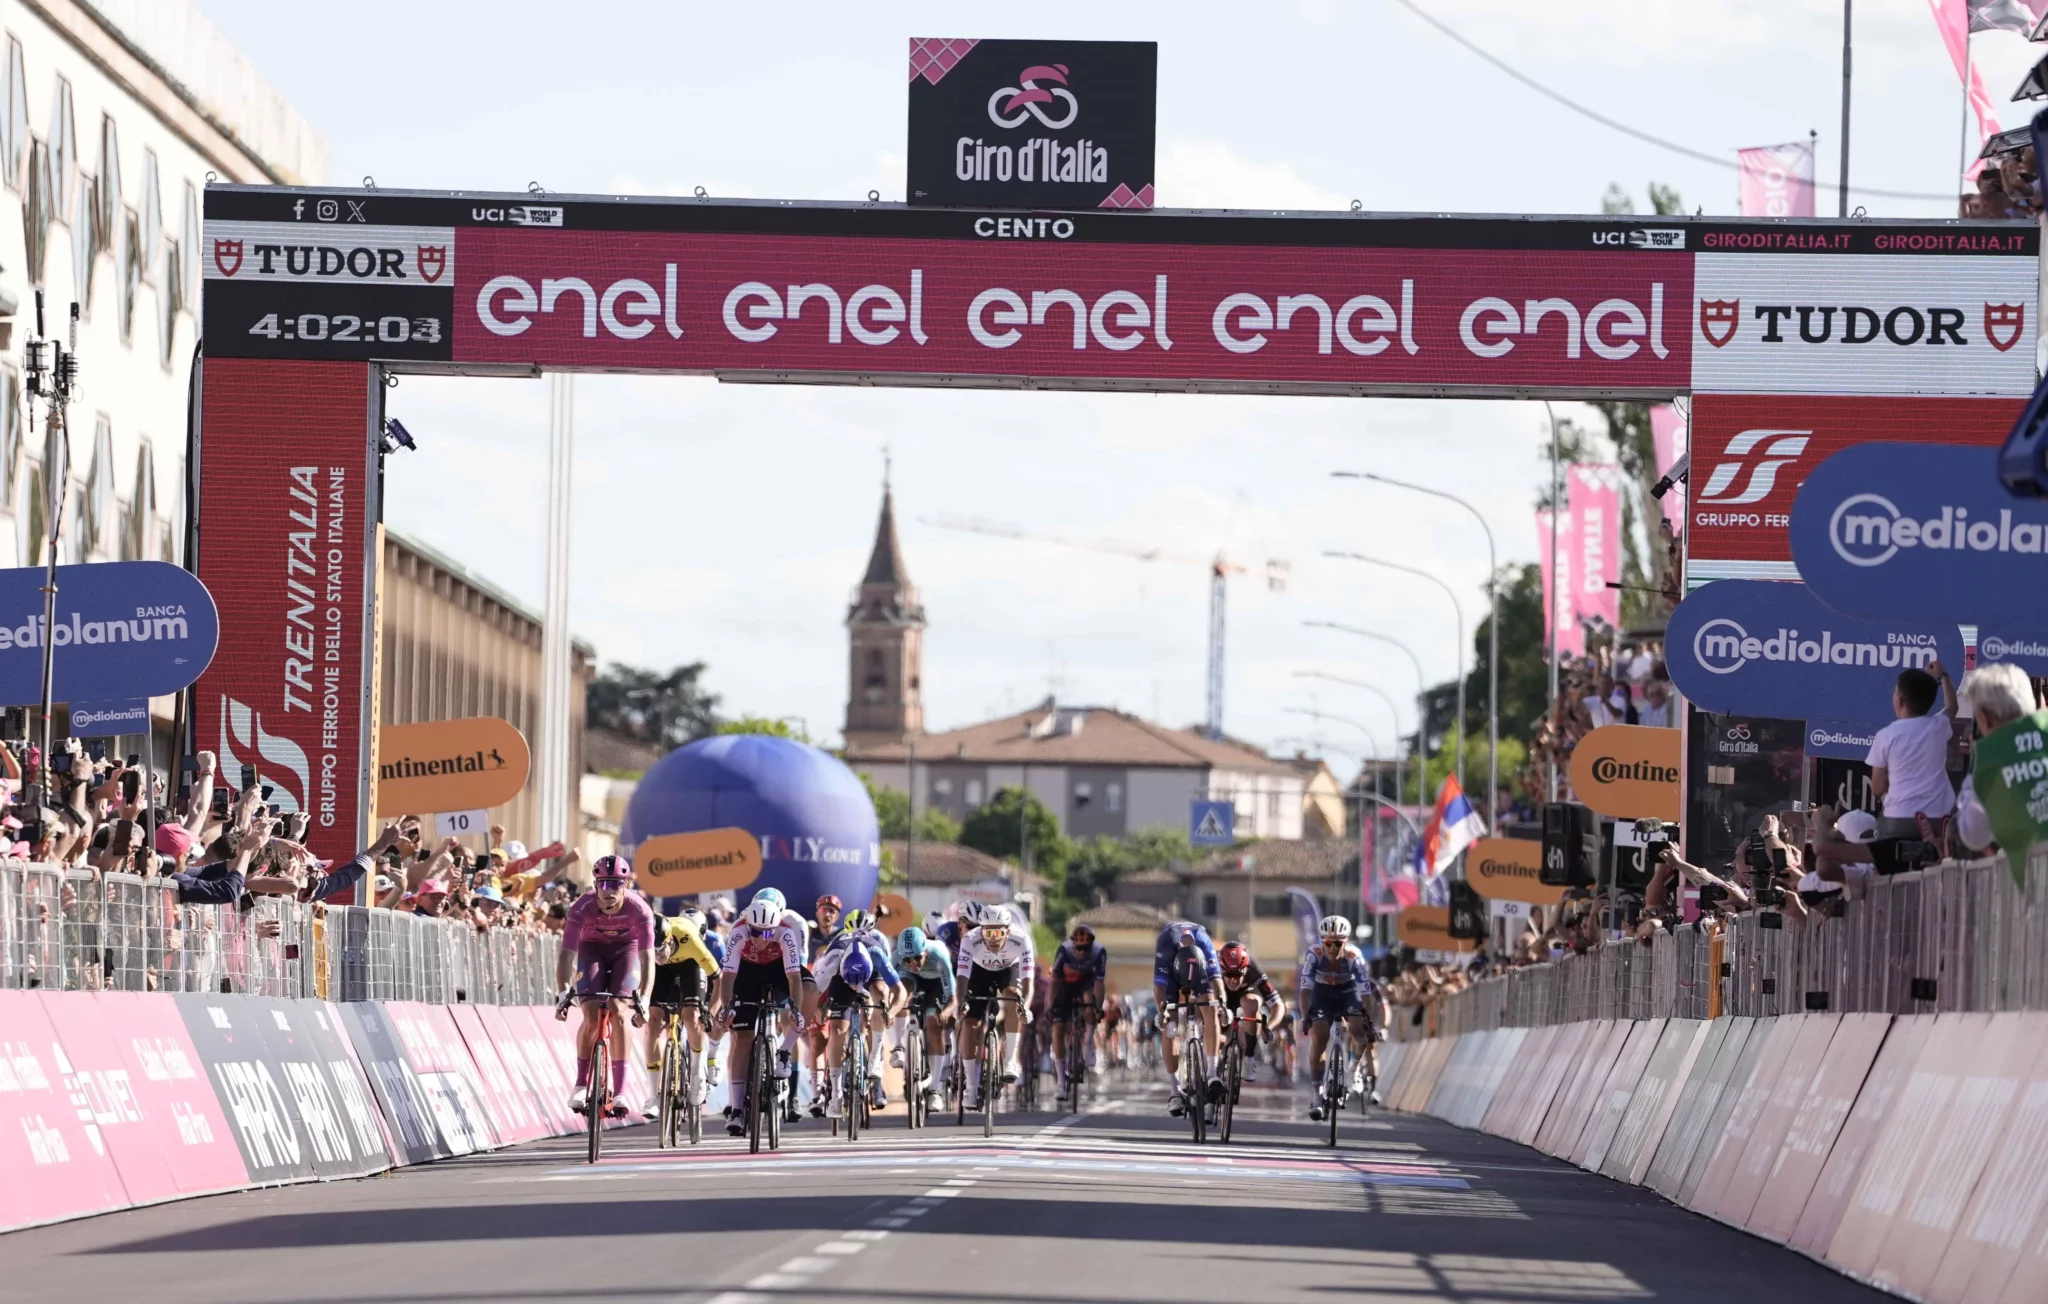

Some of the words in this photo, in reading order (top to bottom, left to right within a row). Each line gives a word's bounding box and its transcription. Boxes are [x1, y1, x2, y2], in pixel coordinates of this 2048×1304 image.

[956, 137, 1012, 182] Giro
[1018, 138, 1108, 184] d'Italia
[472, 208, 504, 221] UCI
[530, 209, 558, 218] WORLD
[531, 216, 551, 224] TOUR
[974, 217, 1075, 238] CENTO
[1651, 231, 1680, 240] WORLD
[1593, 231, 1624, 245] UCI
[1652, 238, 1674, 246] TOUR
[1704, 233, 1852, 249] GIRODITALIA.IT
[1874, 234, 2024, 251] GIRODITALIA.IT
[254, 244, 407, 279] TUDOR
[476, 263, 684, 340] enel
[722, 269, 929, 346] enel
[967, 275, 1173, 351] enel
[1212, 279, 1420, 356] enel
[1459, 283, 1670, 360] enel
[1755, 306, 1967, 346] TUDOR
[329, 466, 345, 544] ITALIANE
[1696, 513, 1760, 527] GRUPPO
[1765, 514, 1790, 527] FER
[1845, 506, 2048, 554] mediola
[327, 549, 343, 603] STATO
[285, 466, 318, 713] TRENITALIA
[136, 605, 186, 618] BANCA
[325, 606, 340, 662] DELLO
[1887, 632, 1937, 646] BANCA
[1705, 628, 1938, 669] mediolanum
[1986, 640, 2048, 658] mediola
[75, 709, 146, 723] mediolanum
[323, 667, 339, 749] FERROVIE
[1719, 741, 1734, 753] Giro
[1735, 741, 1758, 753] d'Italia
[1813, 733, 1876, 747] mediolanu
[2015, 730, 2044, 754] 278
[378, 750, 485, 784] ntinental
[1592, 756, 1681, 784] Contine
[321, 756, 338, 827] GRUPPO
[447, 814, 469, 831] 10
[648, 851, 733, 877] Continental
[1503, 903, 1518, 915] 50
[783, 932, 798, 964] Cofidis
[982, 958, 1009, 967] UAE
